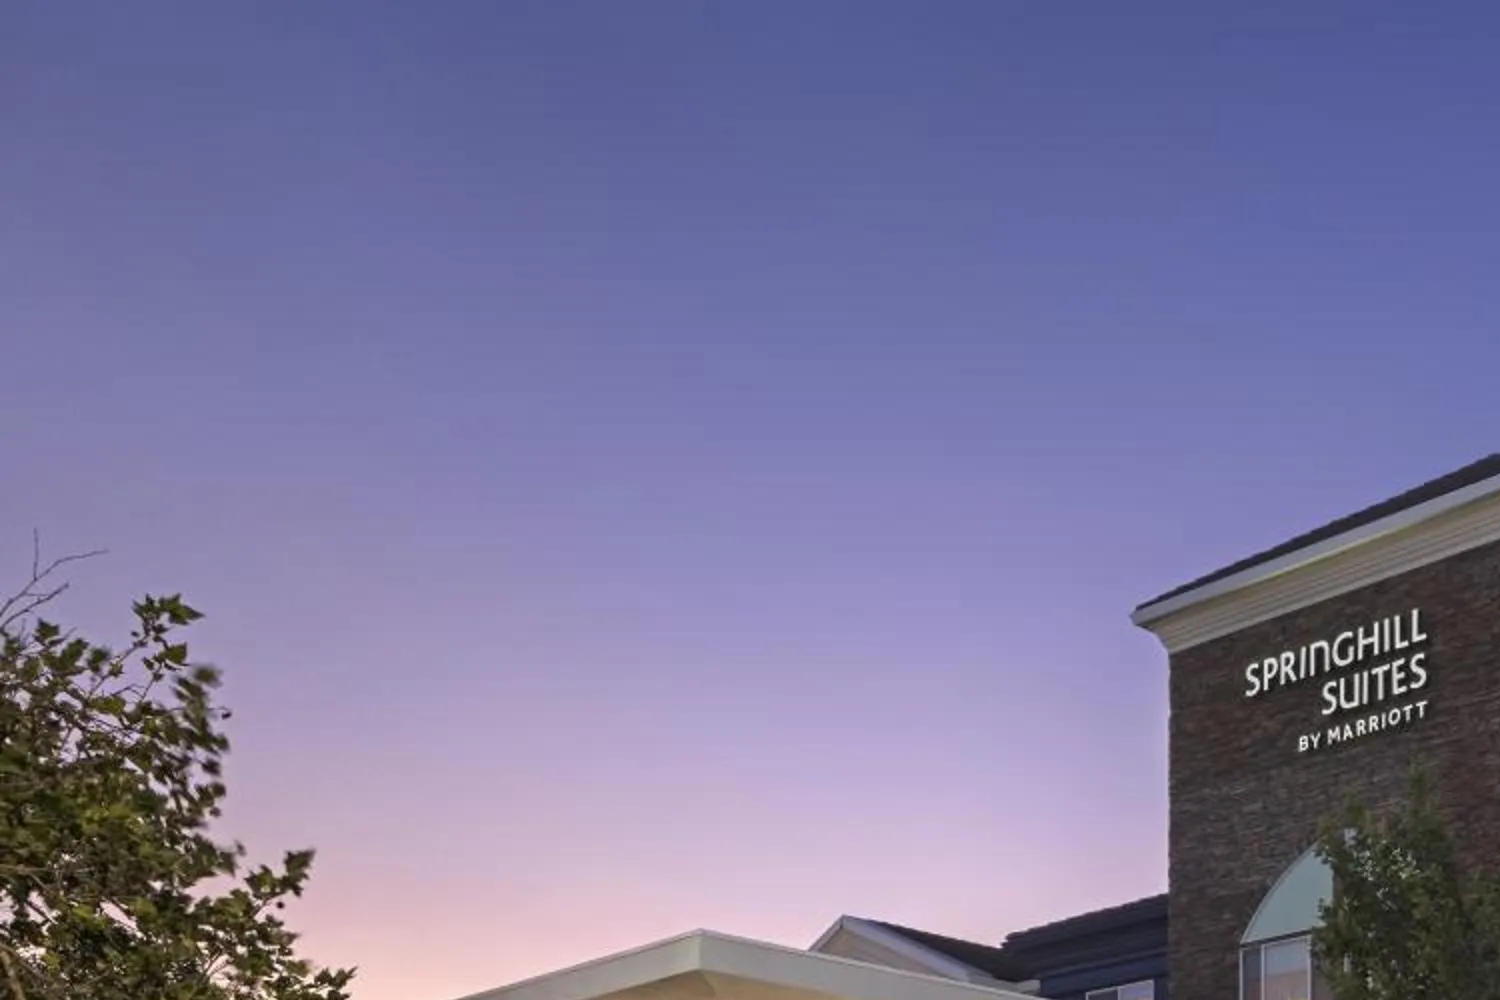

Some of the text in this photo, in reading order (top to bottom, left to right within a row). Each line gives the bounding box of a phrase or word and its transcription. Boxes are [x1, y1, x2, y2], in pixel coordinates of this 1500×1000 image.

[1245, 608, 1428, 697] SPRINGHILL
[1321, 653, 1427, 715] SUITES
[1299, 701, 1428, 752] BY MARRIOTT
